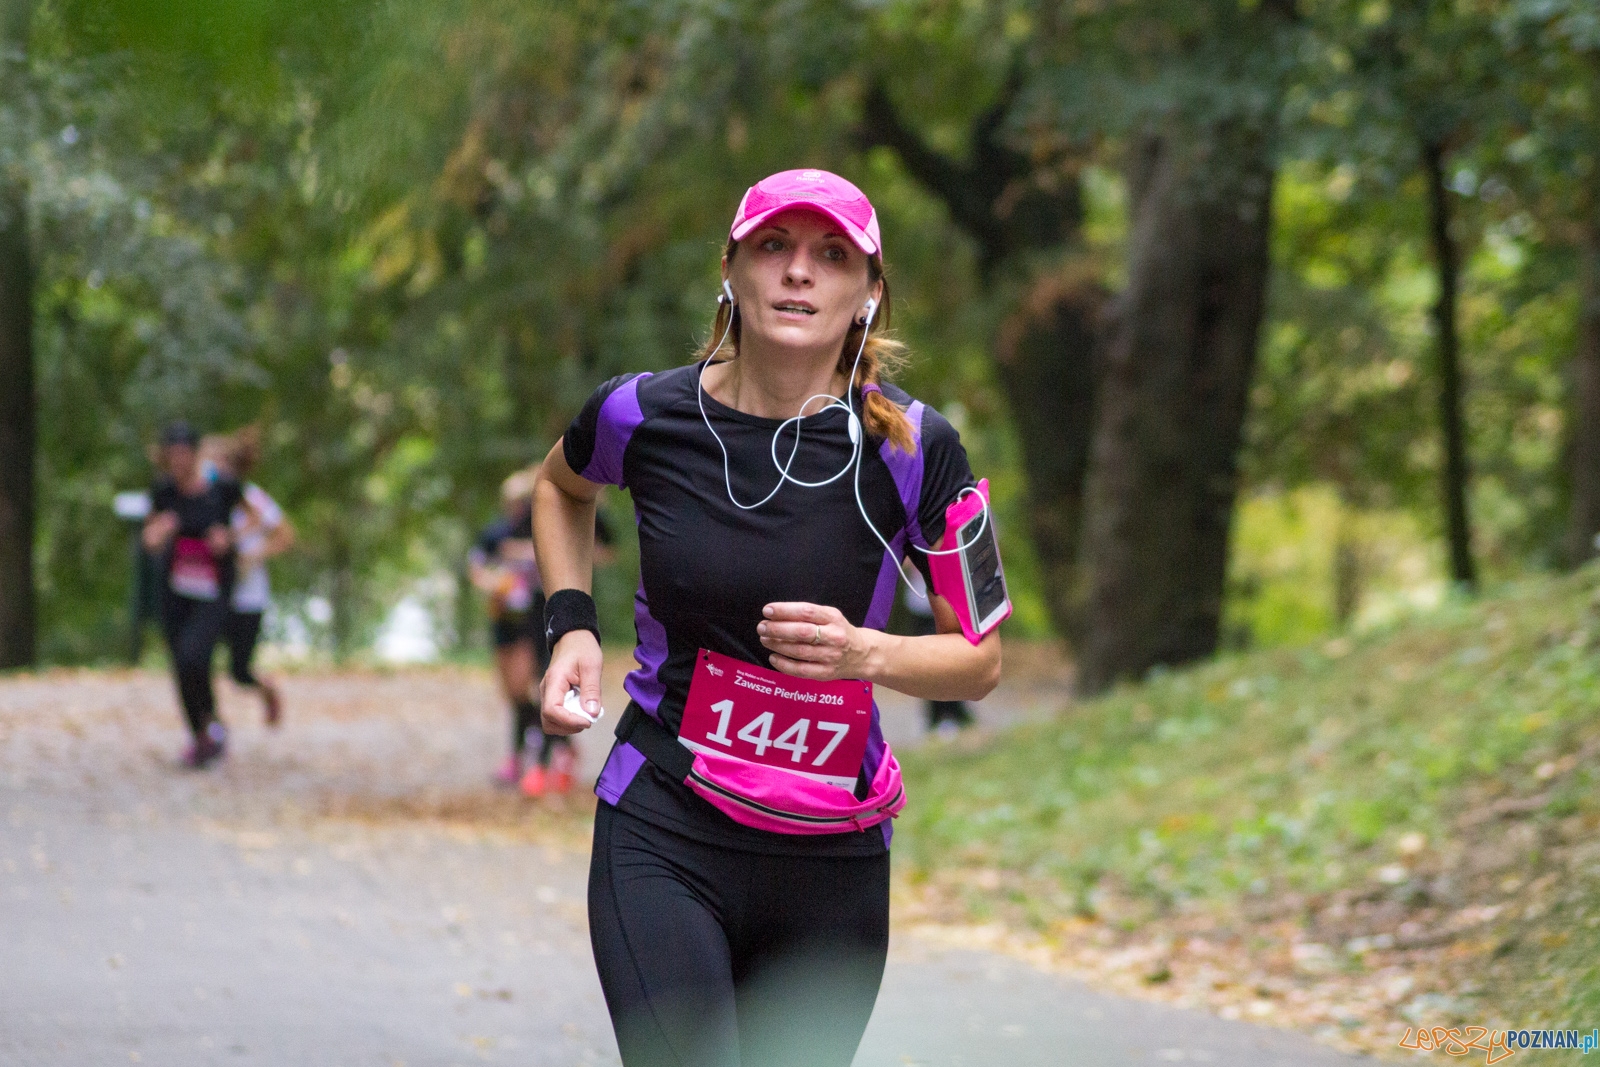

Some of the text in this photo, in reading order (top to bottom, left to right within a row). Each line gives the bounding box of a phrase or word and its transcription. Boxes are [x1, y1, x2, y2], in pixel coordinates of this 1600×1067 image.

[734, 675, 844, 706] Zawsze Pier(w)si 2016
[705, 699, 850, 767] 1447
